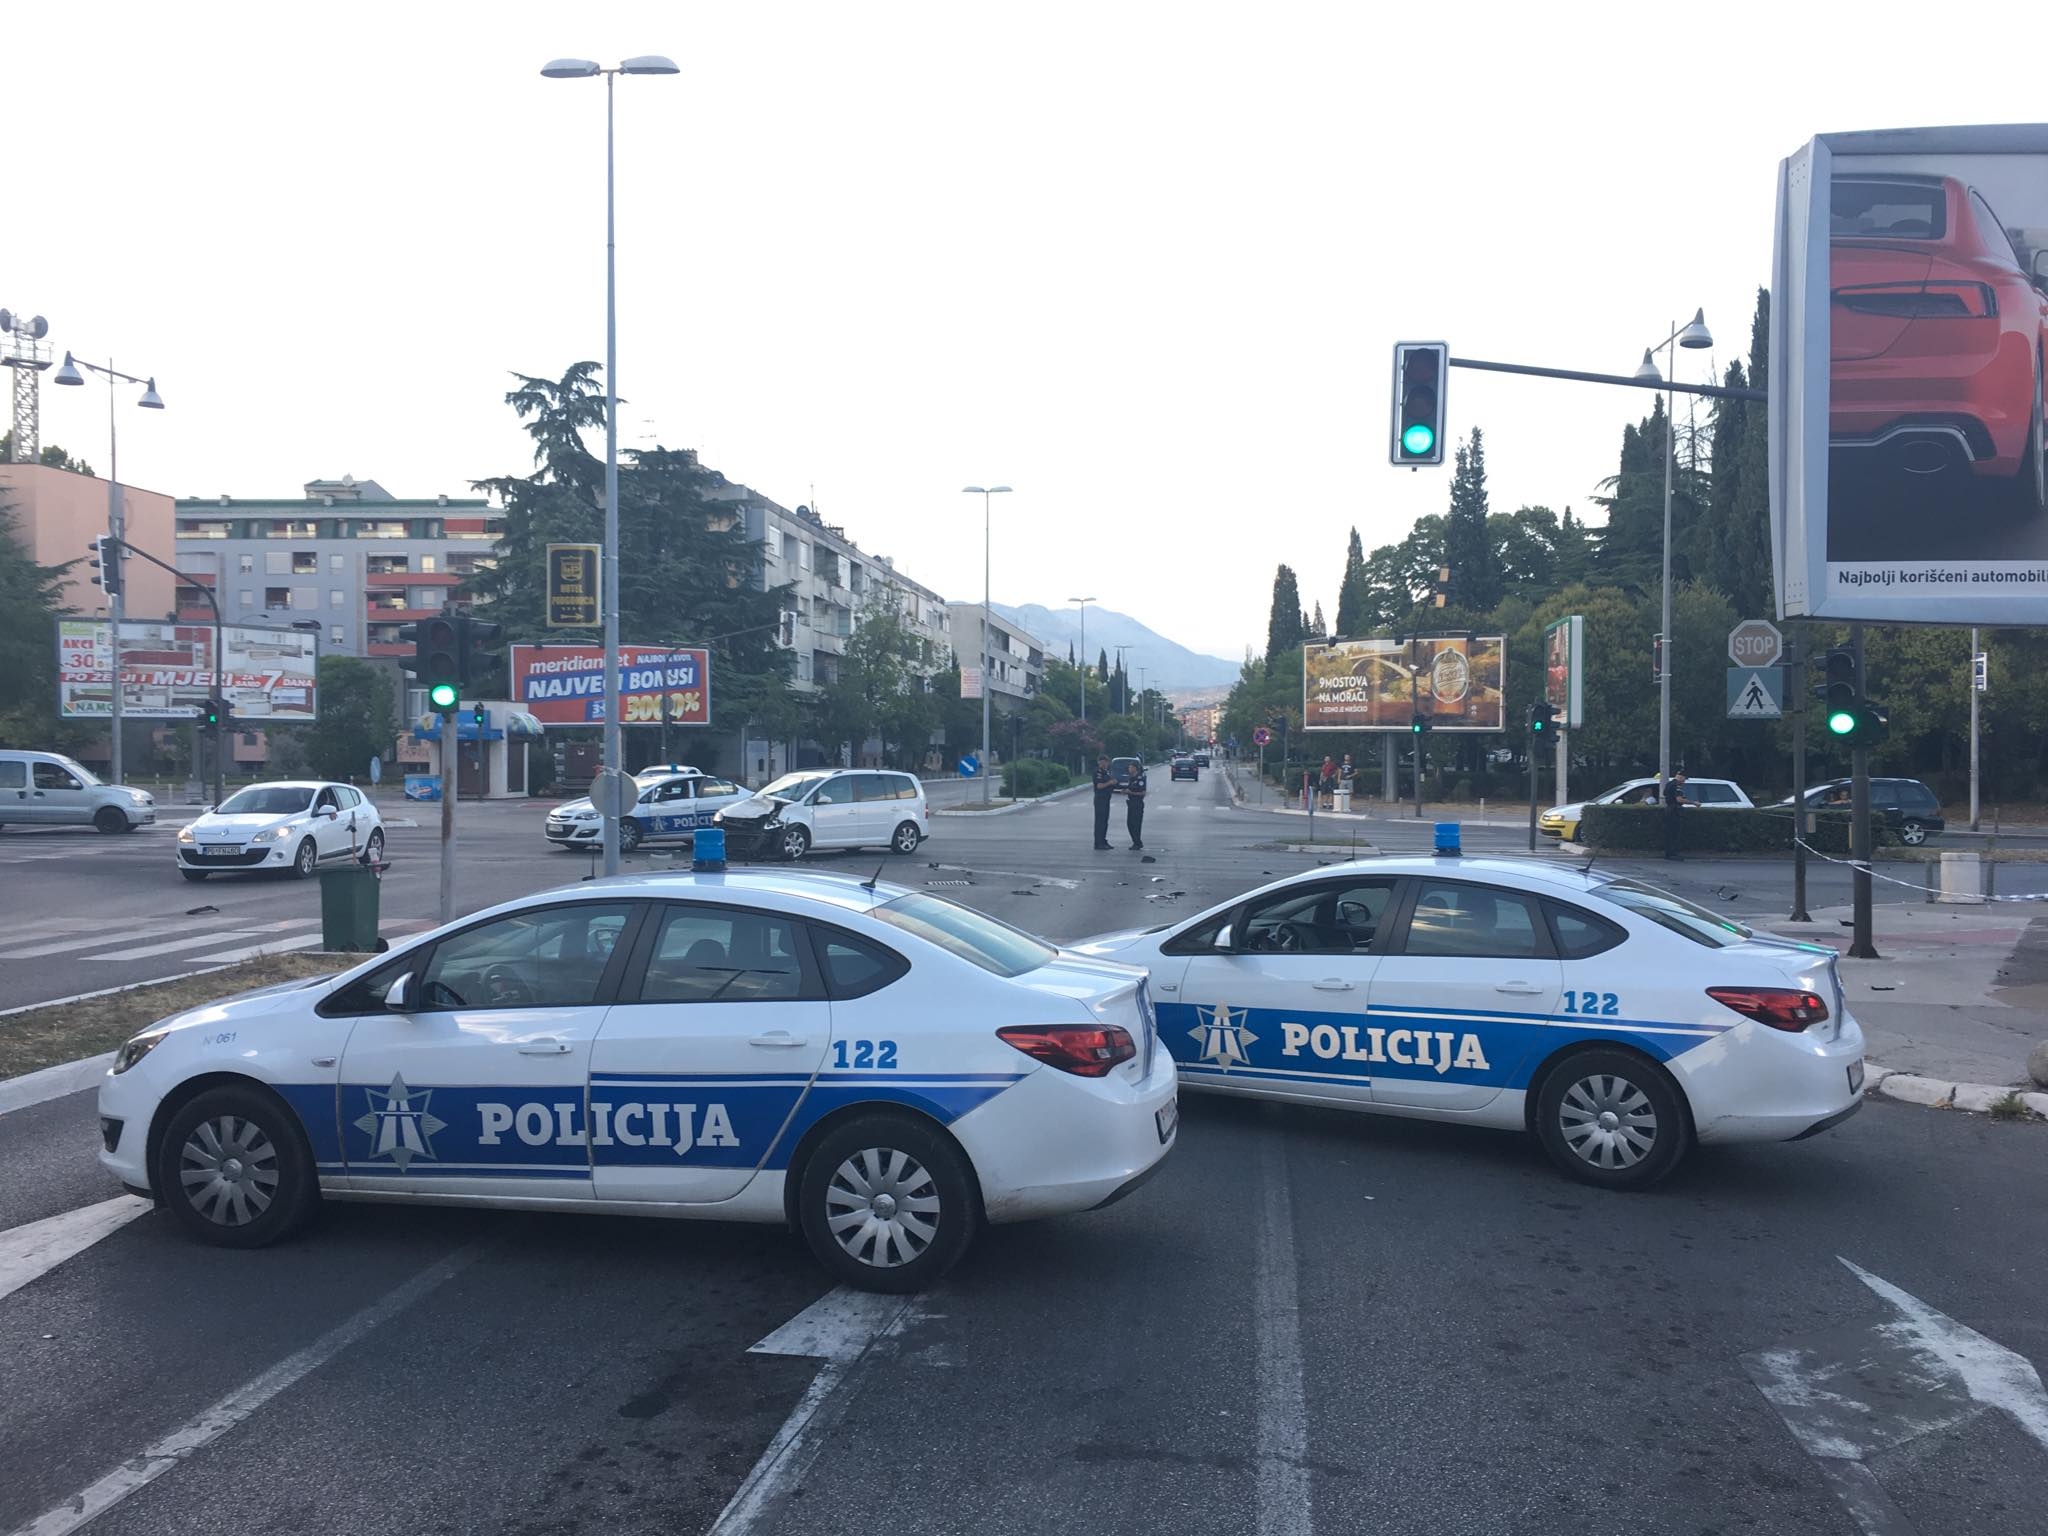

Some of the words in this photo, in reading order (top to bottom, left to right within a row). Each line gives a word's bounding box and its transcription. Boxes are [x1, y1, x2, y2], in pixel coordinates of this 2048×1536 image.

[1838, 570, 1895, 587] Najbolji
[1899, 568, 1968, 583] korišćeni
[1735, 636, 1774, 655] STOP
[529, 654, 629, 674] meridianet
[65, 673, 87, 682] PO
[91, 669, 137, 682] ŽEJI
[151, 671, 235, 686] MJERI
[262, 669, 284, 693] 7
[283, 679, 312, 687] DANA
[528, 676, 622, 699] NAJVEI
[629, 668, 694, 690] BONUSI
[1563, 990, 1618, 1015] 122
[833, 1040, 898, 1068] 122
[1281, 1022, 1490, 1075] POLICIJA
[476, 1102, 740, 1156] POLICIJA
